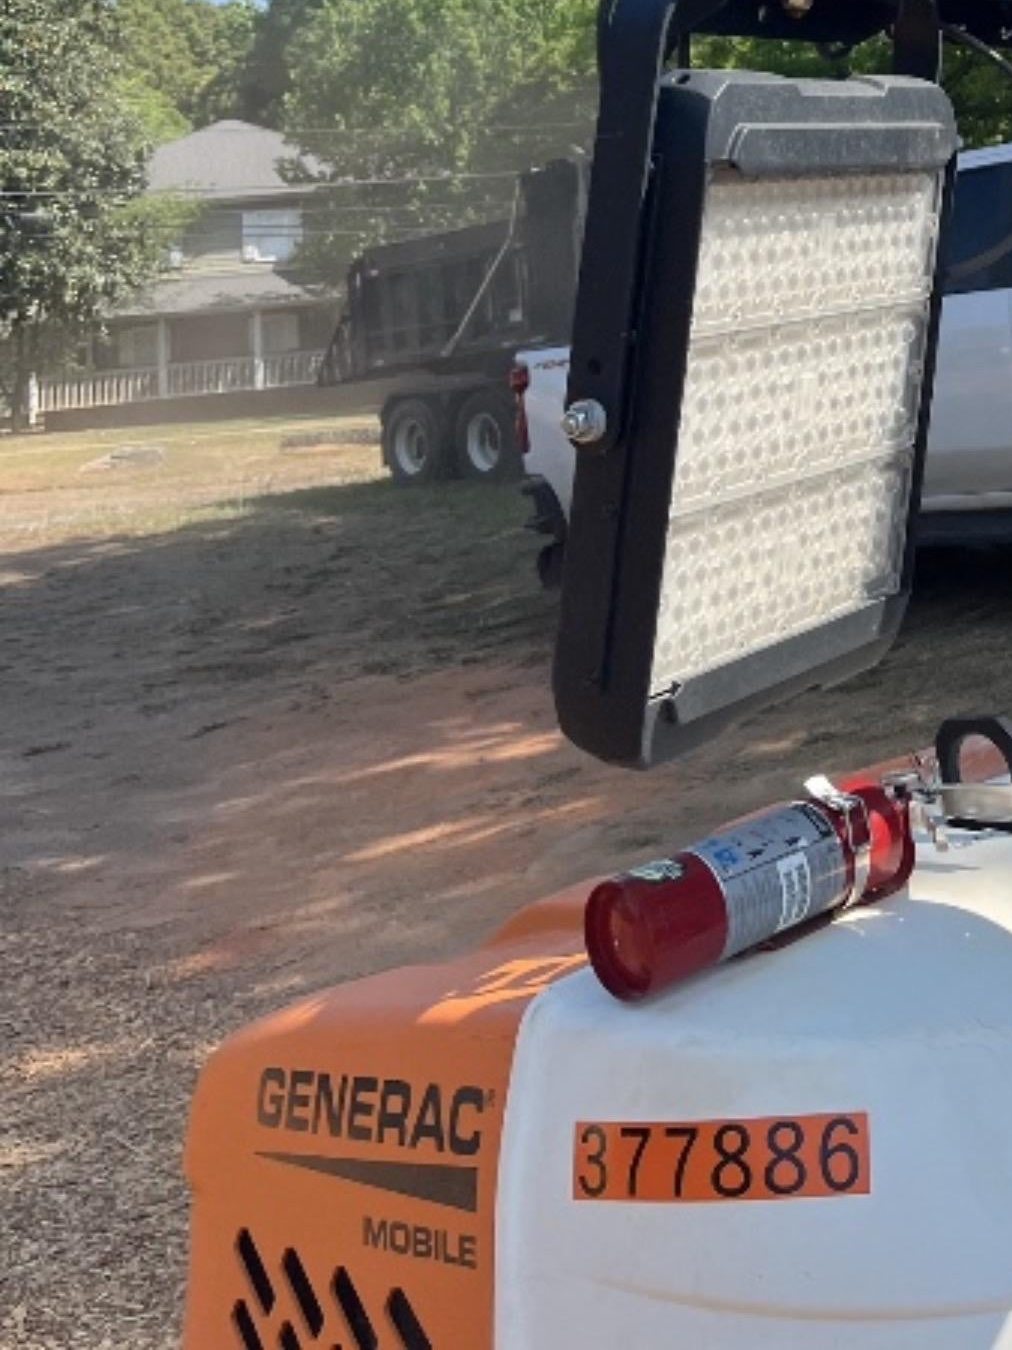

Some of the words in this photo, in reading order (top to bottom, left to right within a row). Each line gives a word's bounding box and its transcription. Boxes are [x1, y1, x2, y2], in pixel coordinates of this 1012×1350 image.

[257, 1067, 485, 1156] GENERAC
[578, 1115, 860, 1198] 377886
[362, 1215, 478, 1269] MOBILE
